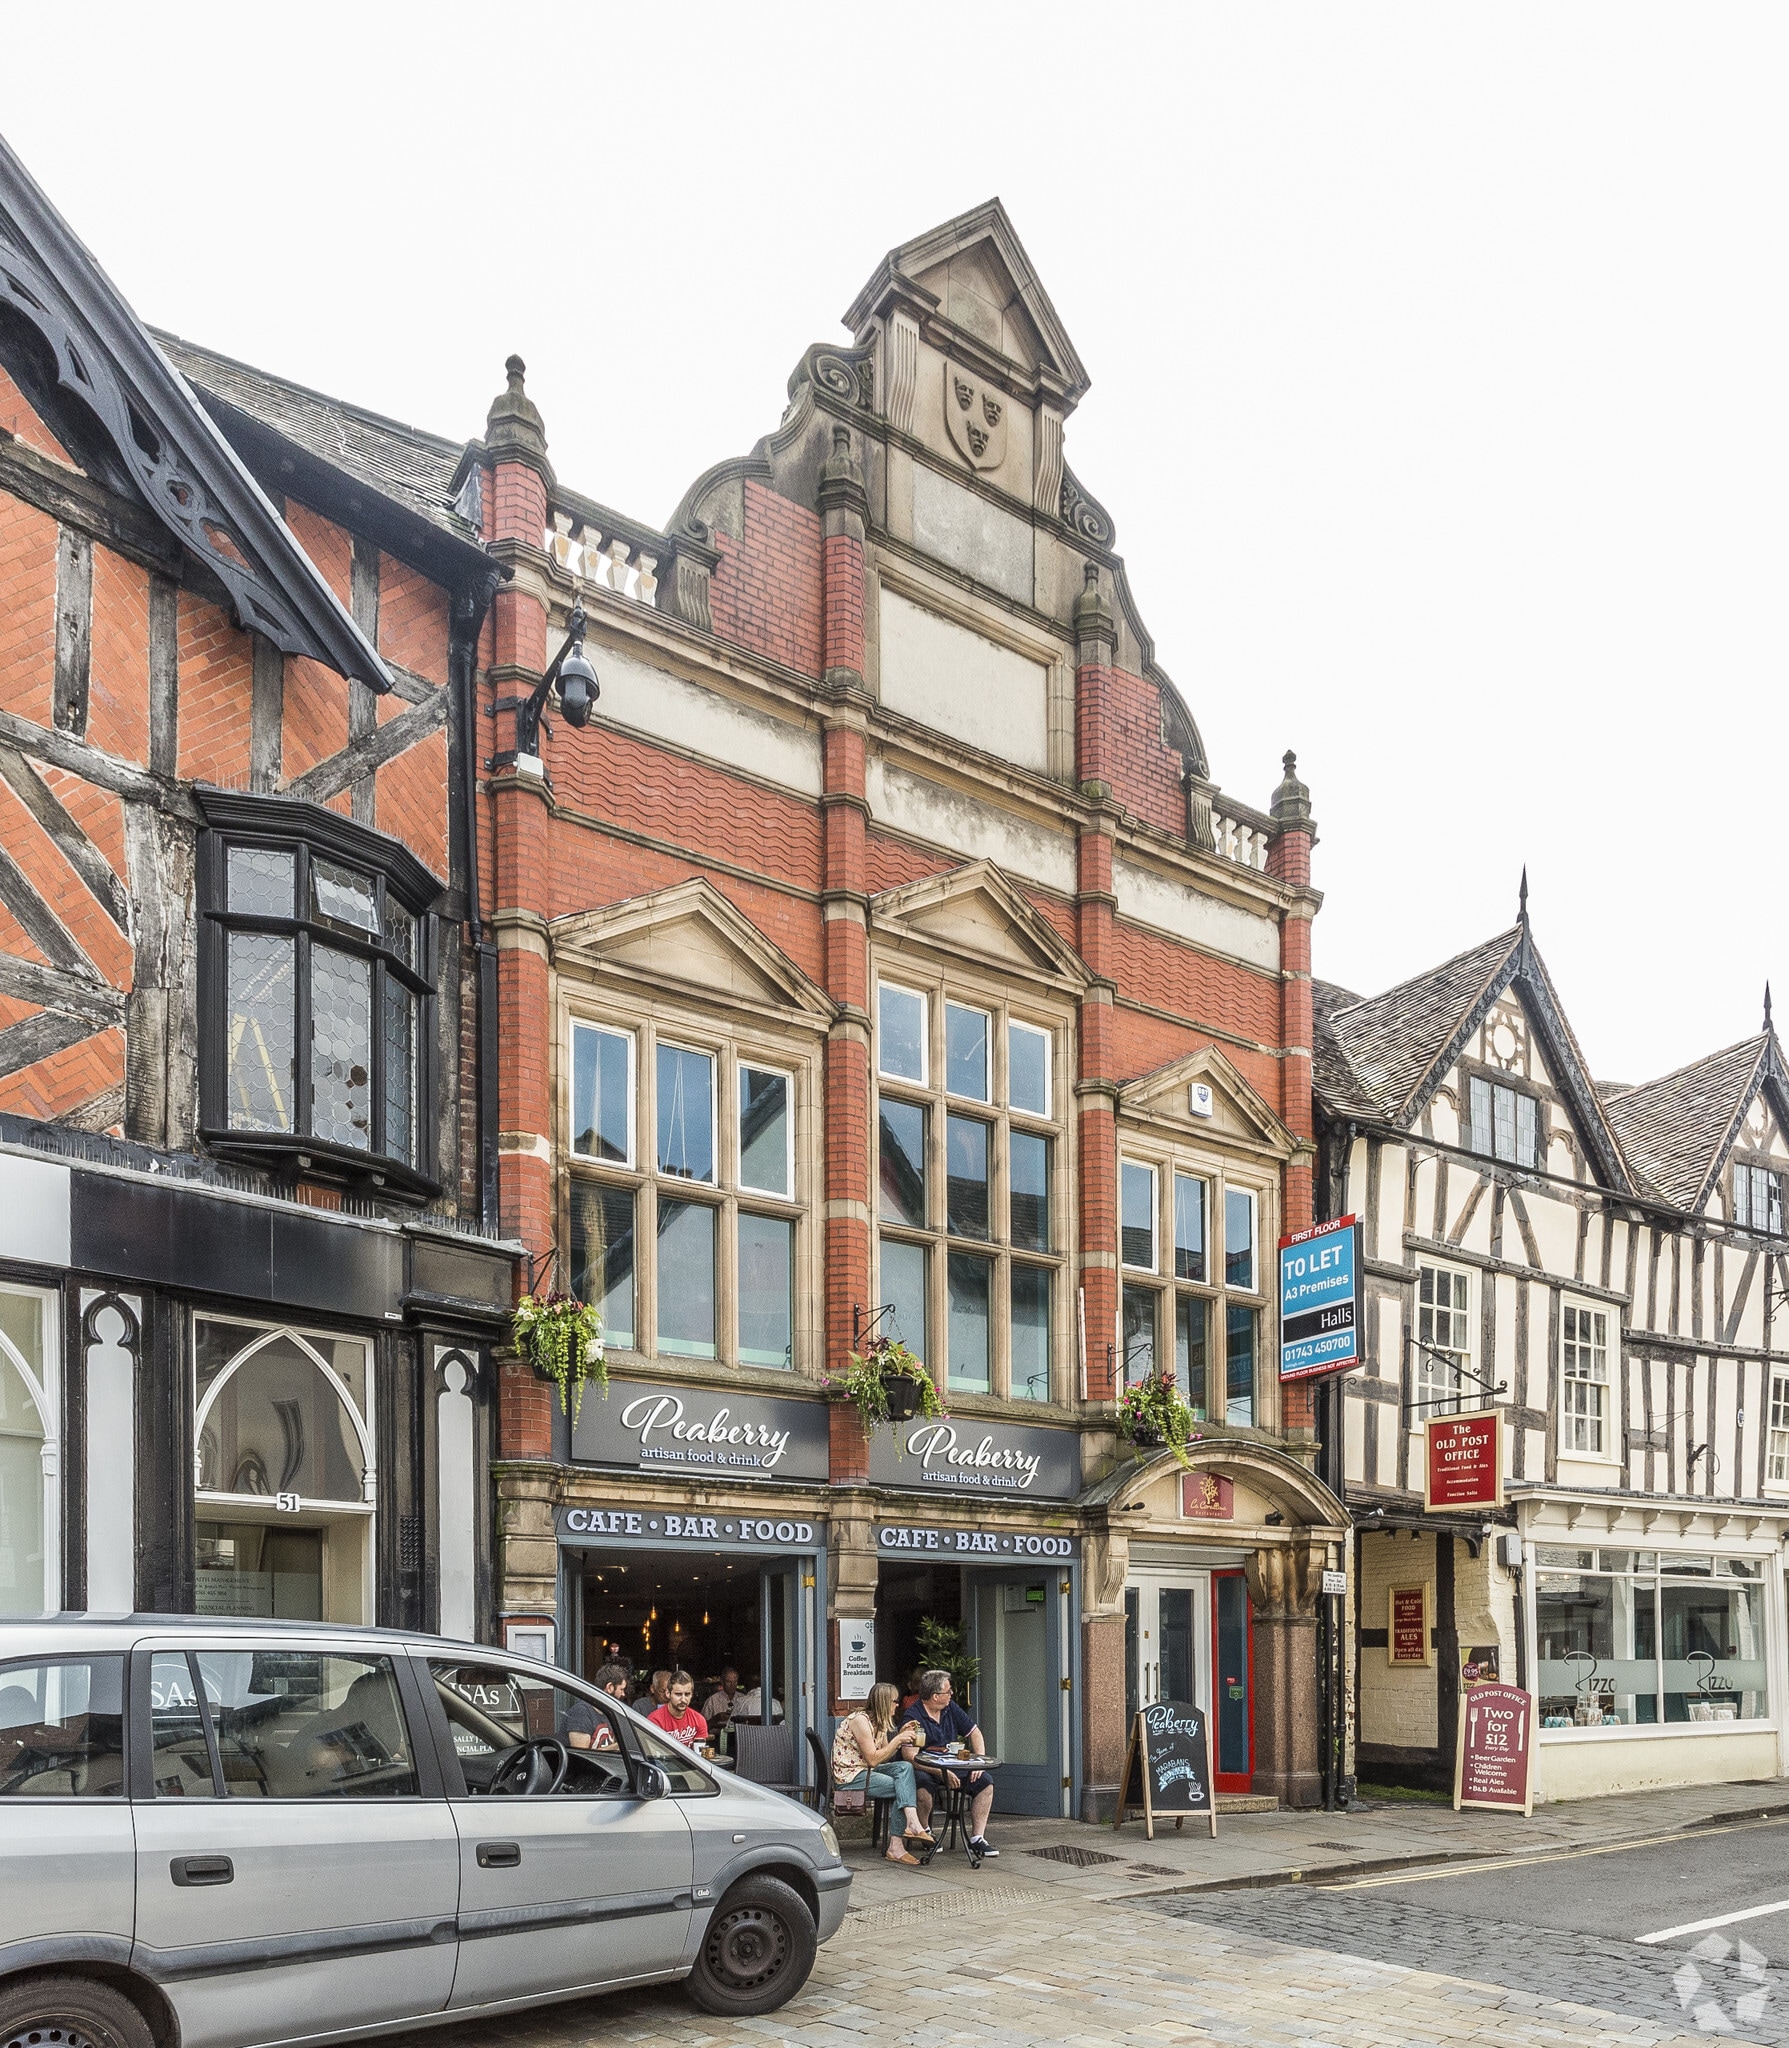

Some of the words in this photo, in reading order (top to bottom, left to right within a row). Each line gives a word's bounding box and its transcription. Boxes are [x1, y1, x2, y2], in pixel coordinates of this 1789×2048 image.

[1292, 1229, 1312, 1243] FIRST
[1315, 1220, 1340, 1235] FLOOR
[1285, 1258, 1305, 1280] TO
[1310, 1245, 1342, 1273] LET
[1285, 1288, 1297, 1301] A3
[1300, 1274, 1348, 1296] Premises
[1322, 1308, 1352, 1328] Halls
[1285, 1345, 1312, 1361] 01743
[1315, 1336, 1350, 1354] 450700
[1336, 1359, 1356, 1367] AFFECTED
[621, 1394, 790, 1468] Peaberry
[1453, 1425, 1471, 1434] The
[1436, 1439, 1456, 1449] OLD
[1462, 1435, 1488, 1446] POST
[641, 1448, 684, 1461] artisan
[687, 1448, 714, 1463] food
[717, 1453, 726, 1464] &
[729, 1454, 761, 1467] drink
[908, 1424, 1040, 1488] Peaberry
[1445, 1449, 1479, 1461] OFFICE
[922, 1471, 957, 1483] artisan
[959, 1472, 980, 1485] food
[982, 1476, 990, 1486] &
[992, 1477, 1017, 1488] drink
[279, 1494, 296, 1510] 51
[567, 1509, 642, 1534] CAFE
[665, 1516, 718, 1539] BAR
[739, 1520, 813, 1543] FOOD
[880, 1528, 939, 1549] CAFE
[956, 1532, 998, 1551] BAR
[1014, 1536, 1072, 1556] FOOD
[1400, 1633, 1418, 1641] ALES
[1470, 1692, 1484, 1702] OLD
[1503, 1692, 1527, 1706] OFFICE
[1147, 1706, 1198, 1736] Peaberry
[1483, 1707, 1514, 1719] Two
[1488, 1720, 1508, 1732] for
[1486, 1734, 1508, 1746] £12
[1475, 1769, 1507, 1777] Welcome
[1489, 1787, 1517, 1795] Available
